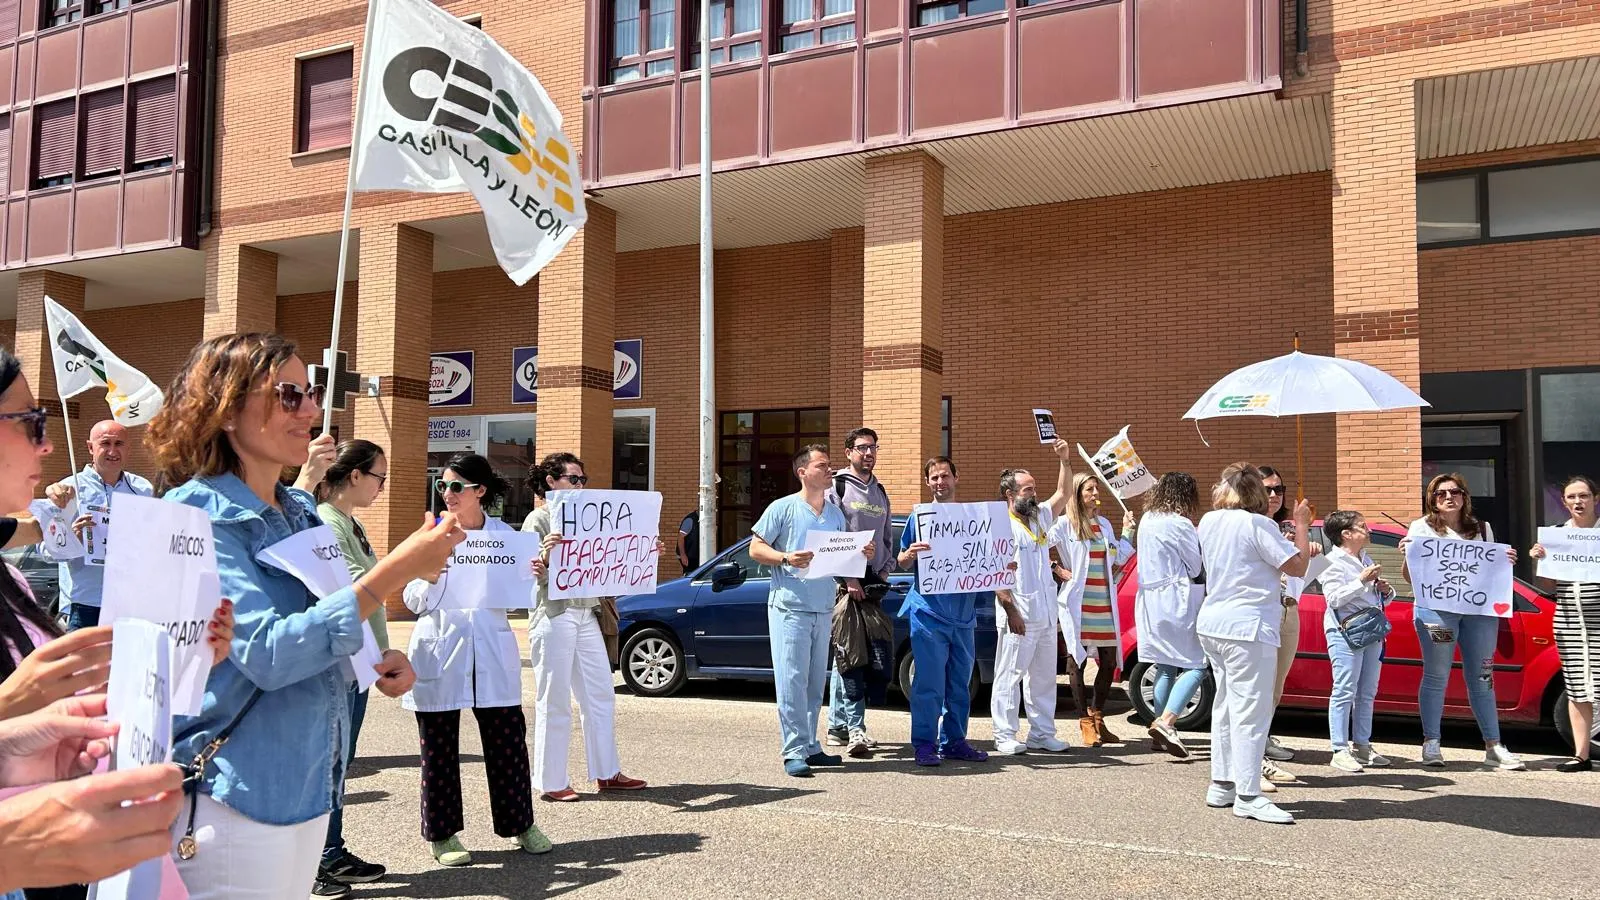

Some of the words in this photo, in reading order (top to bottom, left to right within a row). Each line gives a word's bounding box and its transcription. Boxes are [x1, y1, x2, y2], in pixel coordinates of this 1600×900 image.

[508, 184, 568, 241] LEÓN
[428, 420, 455, 430] RVICIO
[428, 430, 450, 439] ESDE
[453, 429, 471, 438] 1984
[562, 501, 632, 536] HORA
[466, 539, 504, 549] MÉDICOS
[559, 534, 658, 567] TRABAJADA
[819, 545, 857, 553] IGNORADOS
[963, 539, 987, 560] SIN
[991, 538, 1015, 556] NOS
[1421, 539, 1497, 562] SIEMPRE
[453, 554, 516, 565] IGNORADOS
[1437, 560, 1480, 574] SOÑÉ
[556, 564, 654, 591] COMPUTADA
[922, 575, 950, 593] SIN
[1442, 573, 1471, 587] SER
[1421, 583, 1487, 606] MÉDICO
